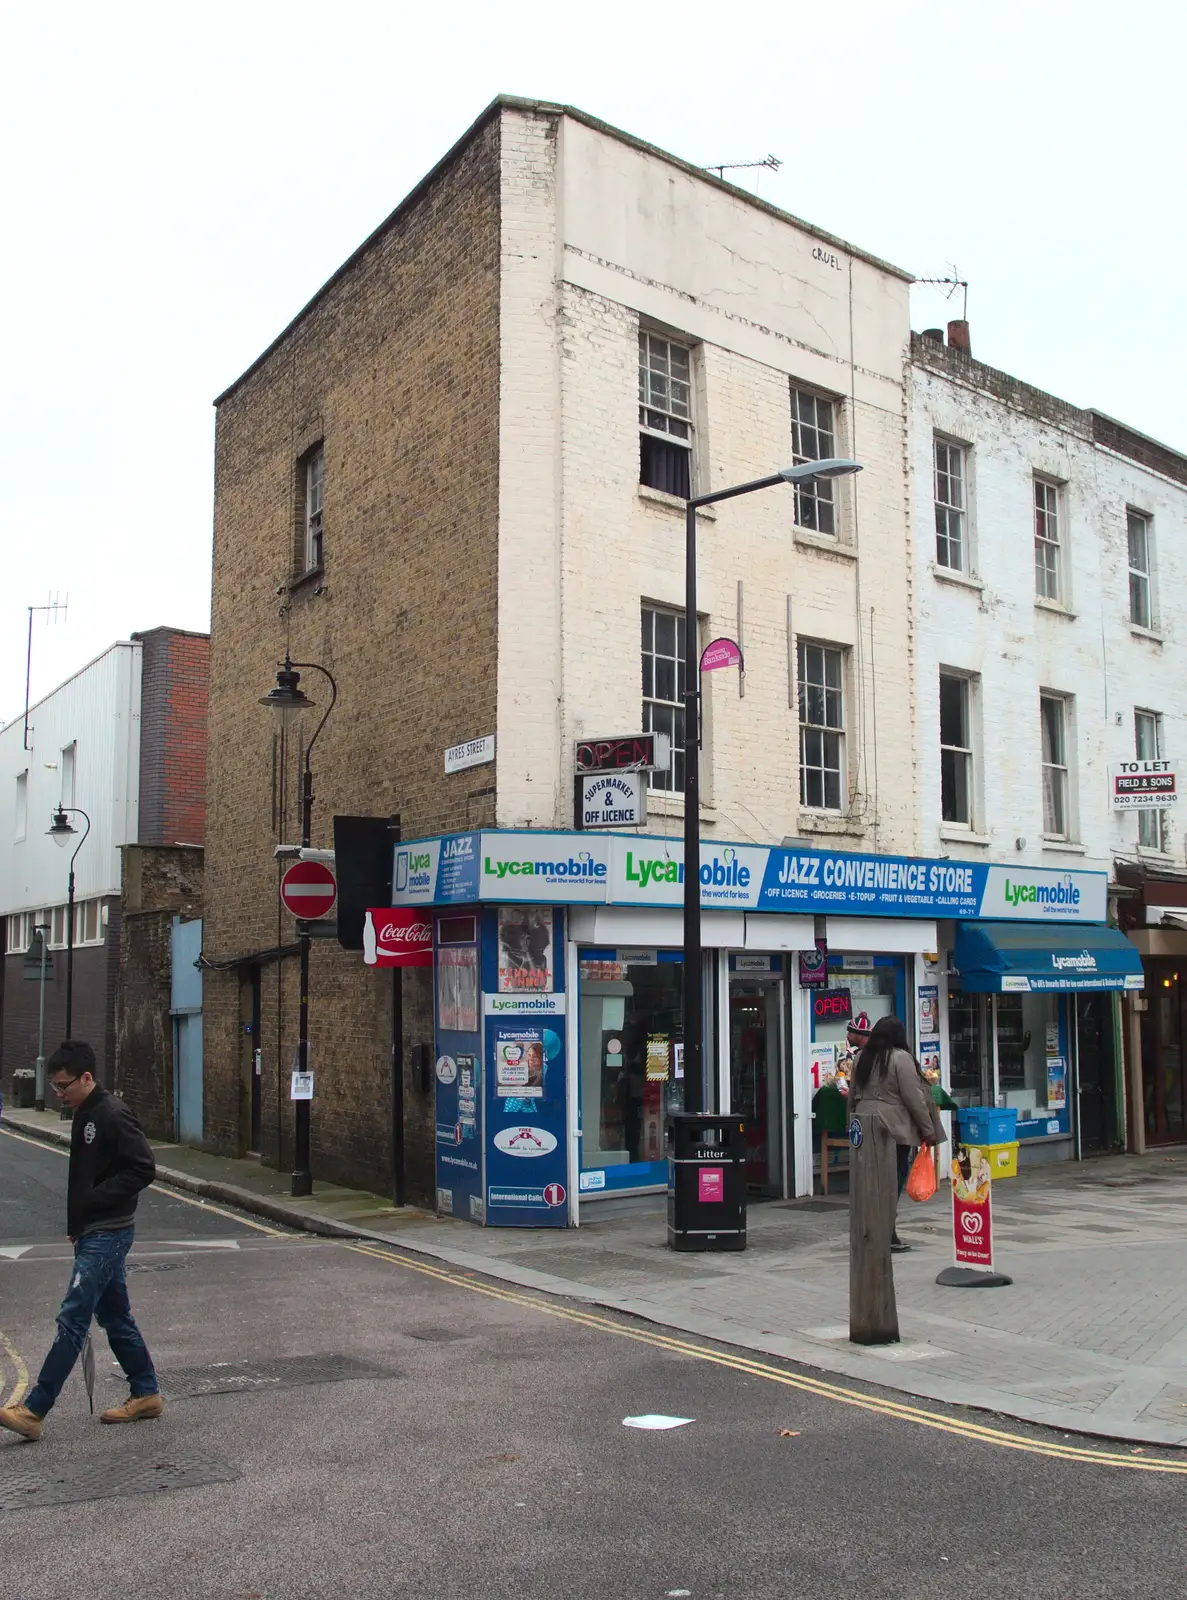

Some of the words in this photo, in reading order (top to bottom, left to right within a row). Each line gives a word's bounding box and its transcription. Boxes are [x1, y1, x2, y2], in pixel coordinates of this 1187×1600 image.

[812, 247, 842, 271] CRUEL
[448, 745, 465, 762] AYRES
[467, 739, 486, 756] STREET
[577, 738, 649, 769] OPEN
[1120, 762, 1139, 773] TO
[1144, 761, 1170, 772] LET
[585, 778, 634, 802] SUPERMARKET
[1118, 779, 1139, 788] FIELD
[1150, 777, 1173, 787] SONS
[604, 792, 613, 807] &
[1114, 796, 1130, 804] 020
[1132, 795, 1154, 803] 7234
[1155, 794, 1178, 802] 9630
[585, 811, 600, 823] OFF
[602, 809, 634, 822] LICENCE
[443, 837, 473, 858] JAZZ
[409, 852, 430, 874] Lyca
[485, 856, 607, 879] Lycamobile
[626, 851, 751, 888] Lycaobile
[409, 872, 430, 887] mobile
[778, 855, 820, 885] JAZZ
[823, 859, 927, 891] CONVENIENCE
[929, 866, 973, 893] STORE
[702, 889, 712, 897] the
[712, 889, 729, 898] world
[729, 890, 738, 898] for
[738, 890, 749, 899] less
[767, 888, 780, 897] OFF
[781, 888, 809, 898] LICENCE
[813, 890, 846, 900] GROCERIES
[850, 892, 876, 902] E-TOPUP
[881, 894, 897, 902] FRUIT
[898, 894, 903, 903] &
[903, 894, 934, 904] VEGETABLE
[937, 897, 959, 905] CALLING
[960, 897, 976, 906] CARDS
[1005, 878, 1080, 906] Lycamobile
[380, 922, 433, 942] Coca-Cola
[1052, 954, 1097, 970] Lycamobile
[499, 968, 551, 977] KENDALL
[801, 972, 825, 980] payzone
[492, 999, 556, 1010] Lycamobile
[814, 996, 849, 1015] OPEN
[498, 1031, 539, 1039] Lycamobile
[810, 1061, 820, 1089] 1
[697, 1150, 725, 1158] Litter
[490, 1193, 528, 1201] International
[528, 1194, 543, 1202] Calls
[549, 1185, 558, 1205] 1
[962, 1234, 984, 1245] WALL'S
